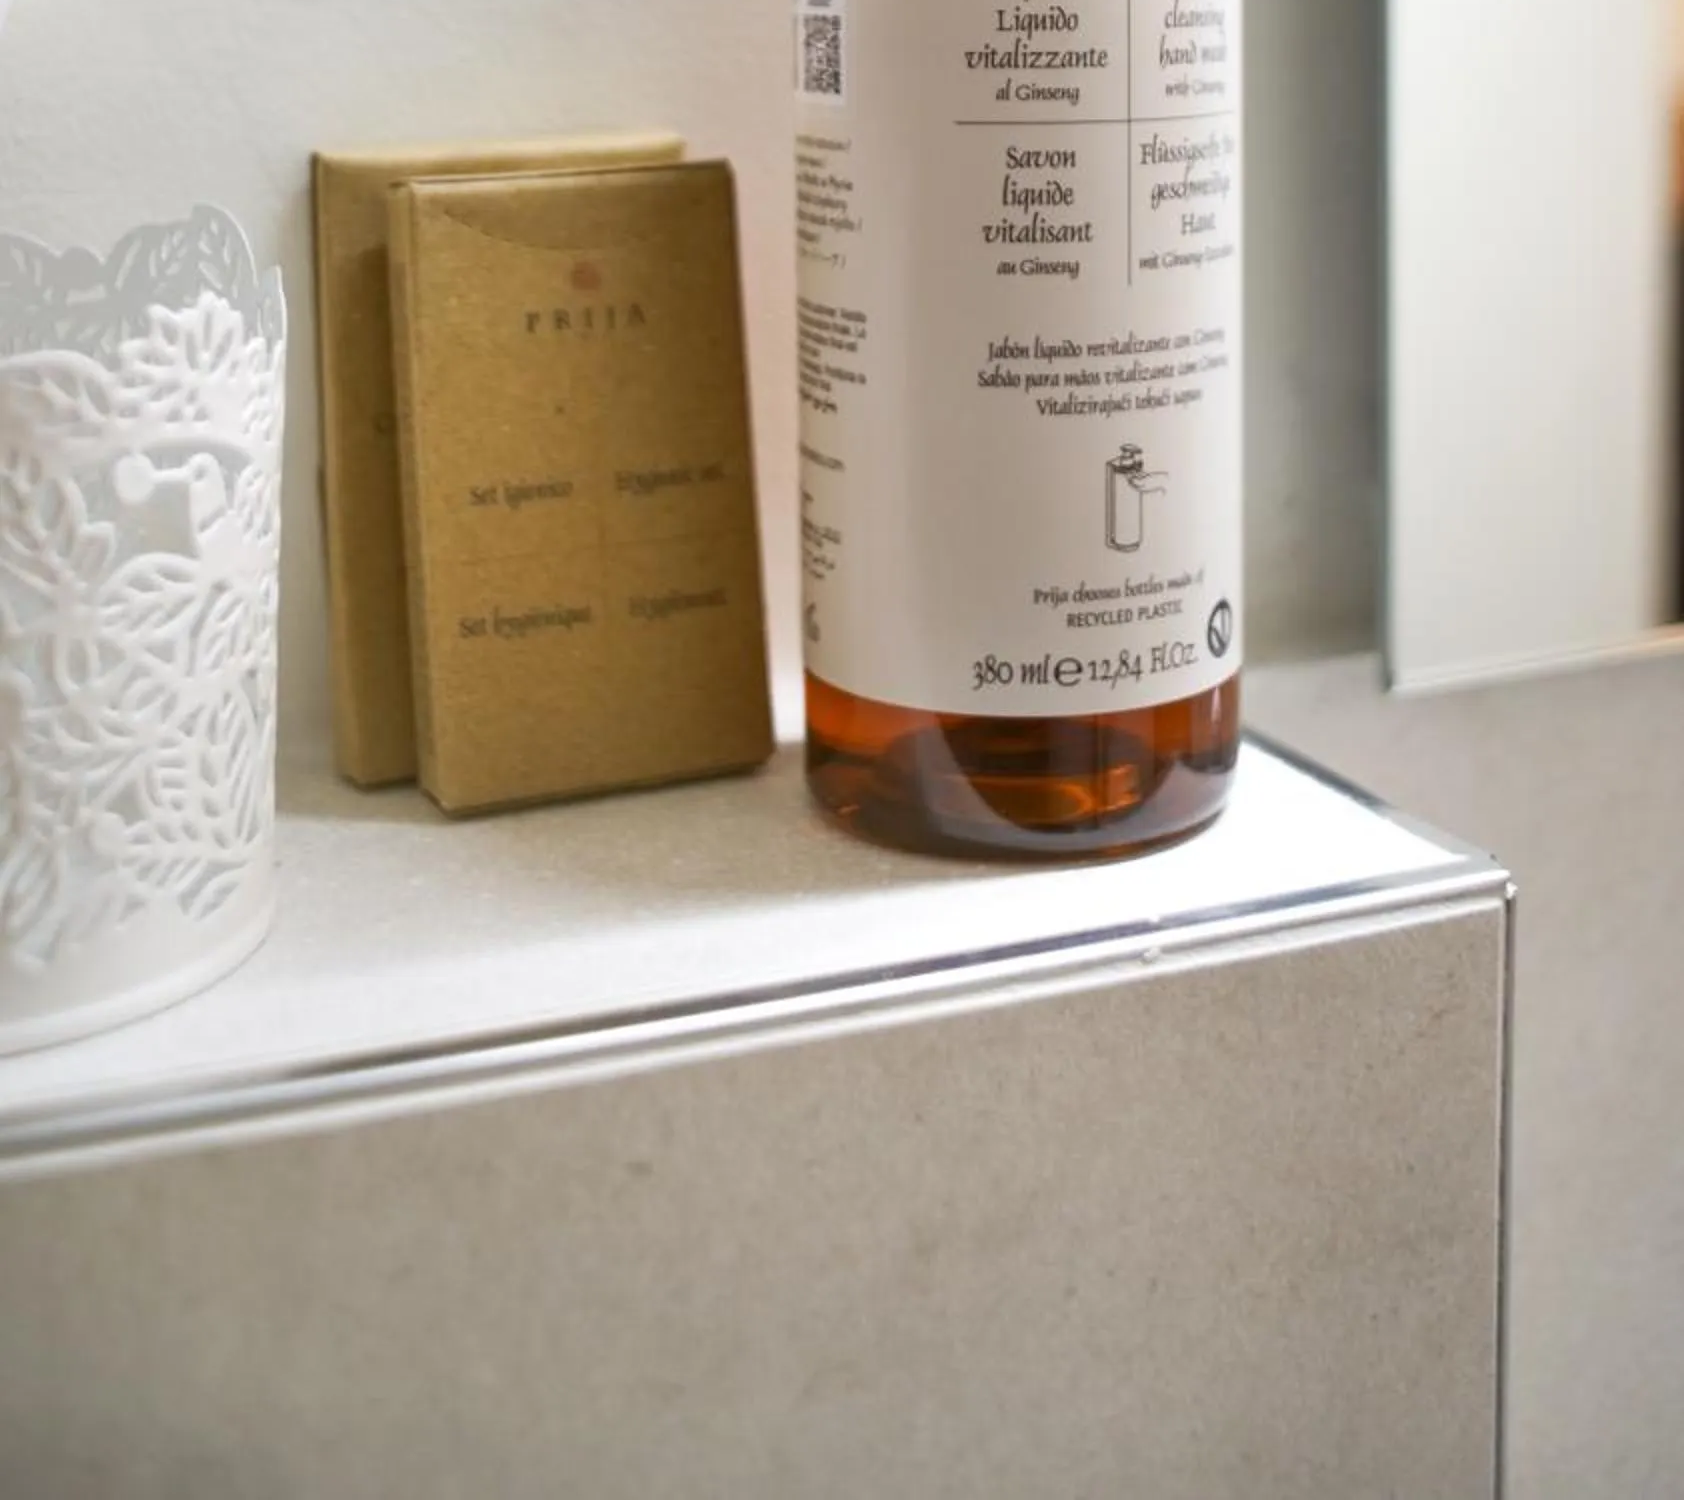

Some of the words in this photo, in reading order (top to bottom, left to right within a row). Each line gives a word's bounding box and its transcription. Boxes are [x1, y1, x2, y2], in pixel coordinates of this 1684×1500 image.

[996, 5, 1079, 40] Liquido
[964, 37, 1109, 69] vitalizzante
[995, 77, 1011, 101] al
[1015, 83, 1080, 106] Ginseng
[1006, 146, 1076, 170] Savon
[1002, 174, 1075, 214] liquide
[981, 212, 1093, 244] vitalisant
[996, 261, 1017, 275] au
[1019, 256, 1080, 279] Ginseng
[524, 303, 646, 334] PRIJA
[1025, 371, 1059, 393] para
[469, 485, 498, 506] Set
[1033, 586, 1069, 608] Prija
[459, 616, 487, 639] Set
[1066, 608, 1132, 628] RECYCLED
[1137, 600, 1184, 621] PLASTIC
[972, 653, 1014, 692] 380
[1021, 653, 1051, 685] ml
[1087, 649, 1144, 690] 12,84
